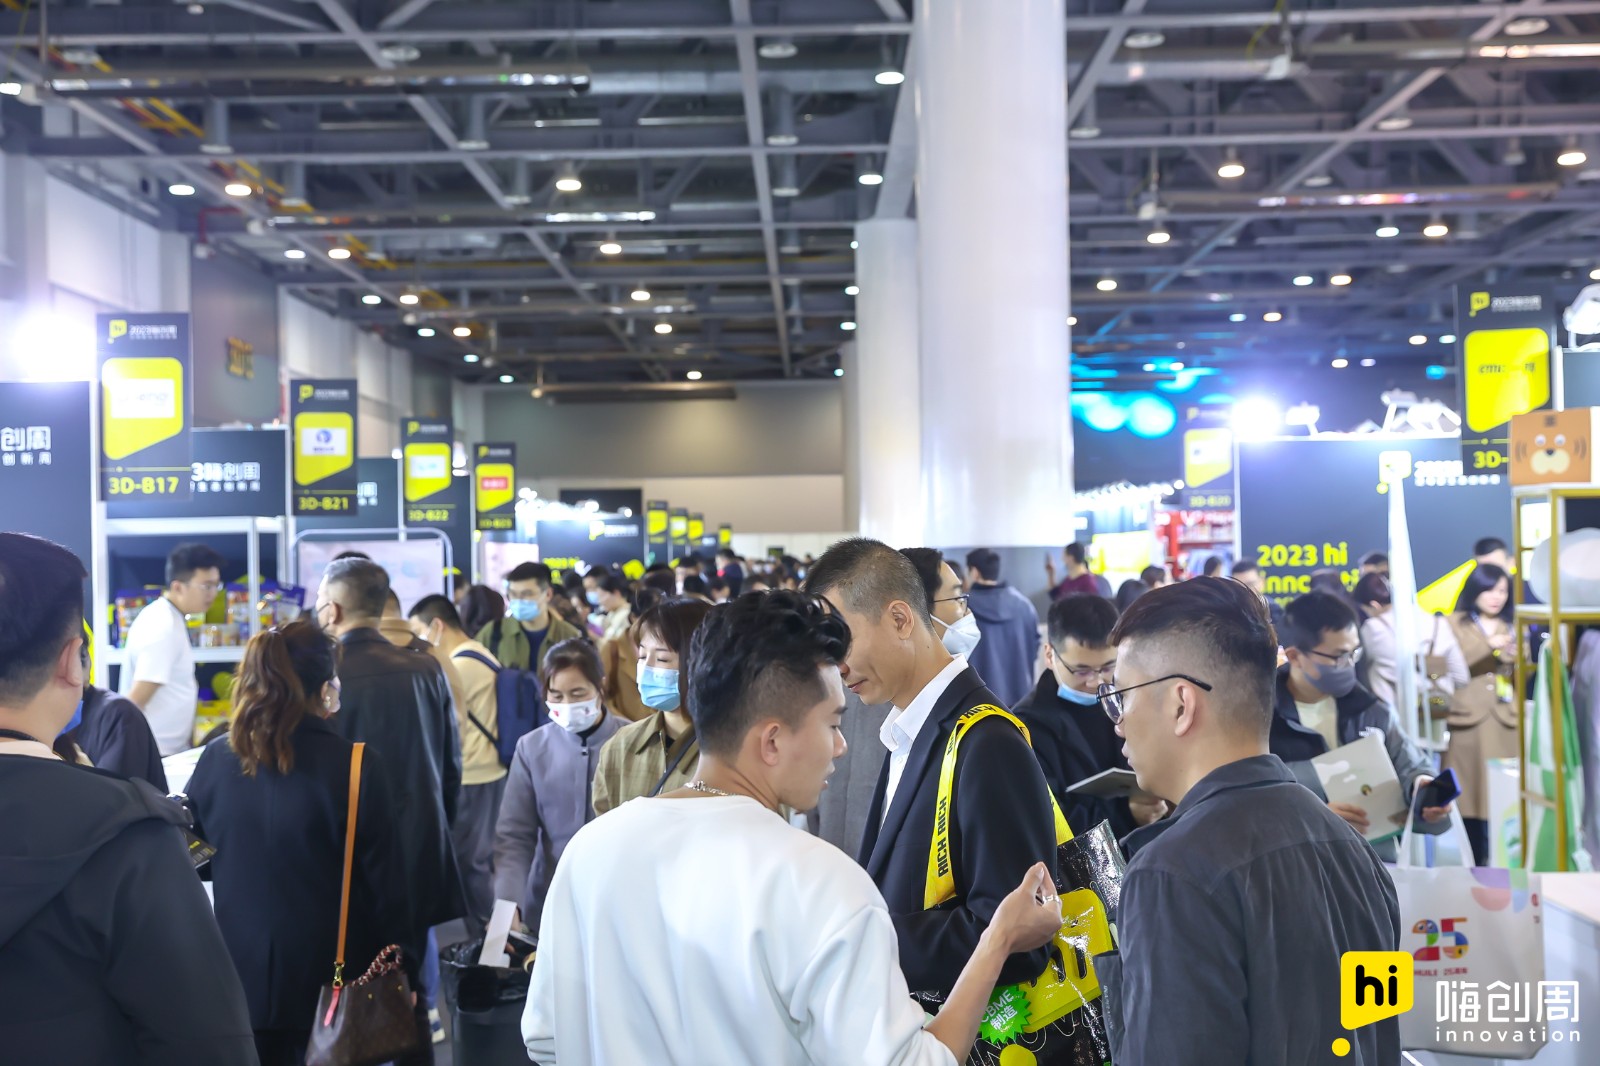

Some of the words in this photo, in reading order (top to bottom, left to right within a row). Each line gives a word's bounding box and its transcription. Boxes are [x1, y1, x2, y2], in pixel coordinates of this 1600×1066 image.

[109, 477, 179, 494] 3D-B17
[1257, 544, 1318, 566] 2023
[1323, 541, 1348, 566] hi
[937, 796, 947, 836] RICH
[937, 838, 949, 878] RICH
[1412, 917, 1469, 961] 25
[990, 1004, 1019, 1031] 制造
